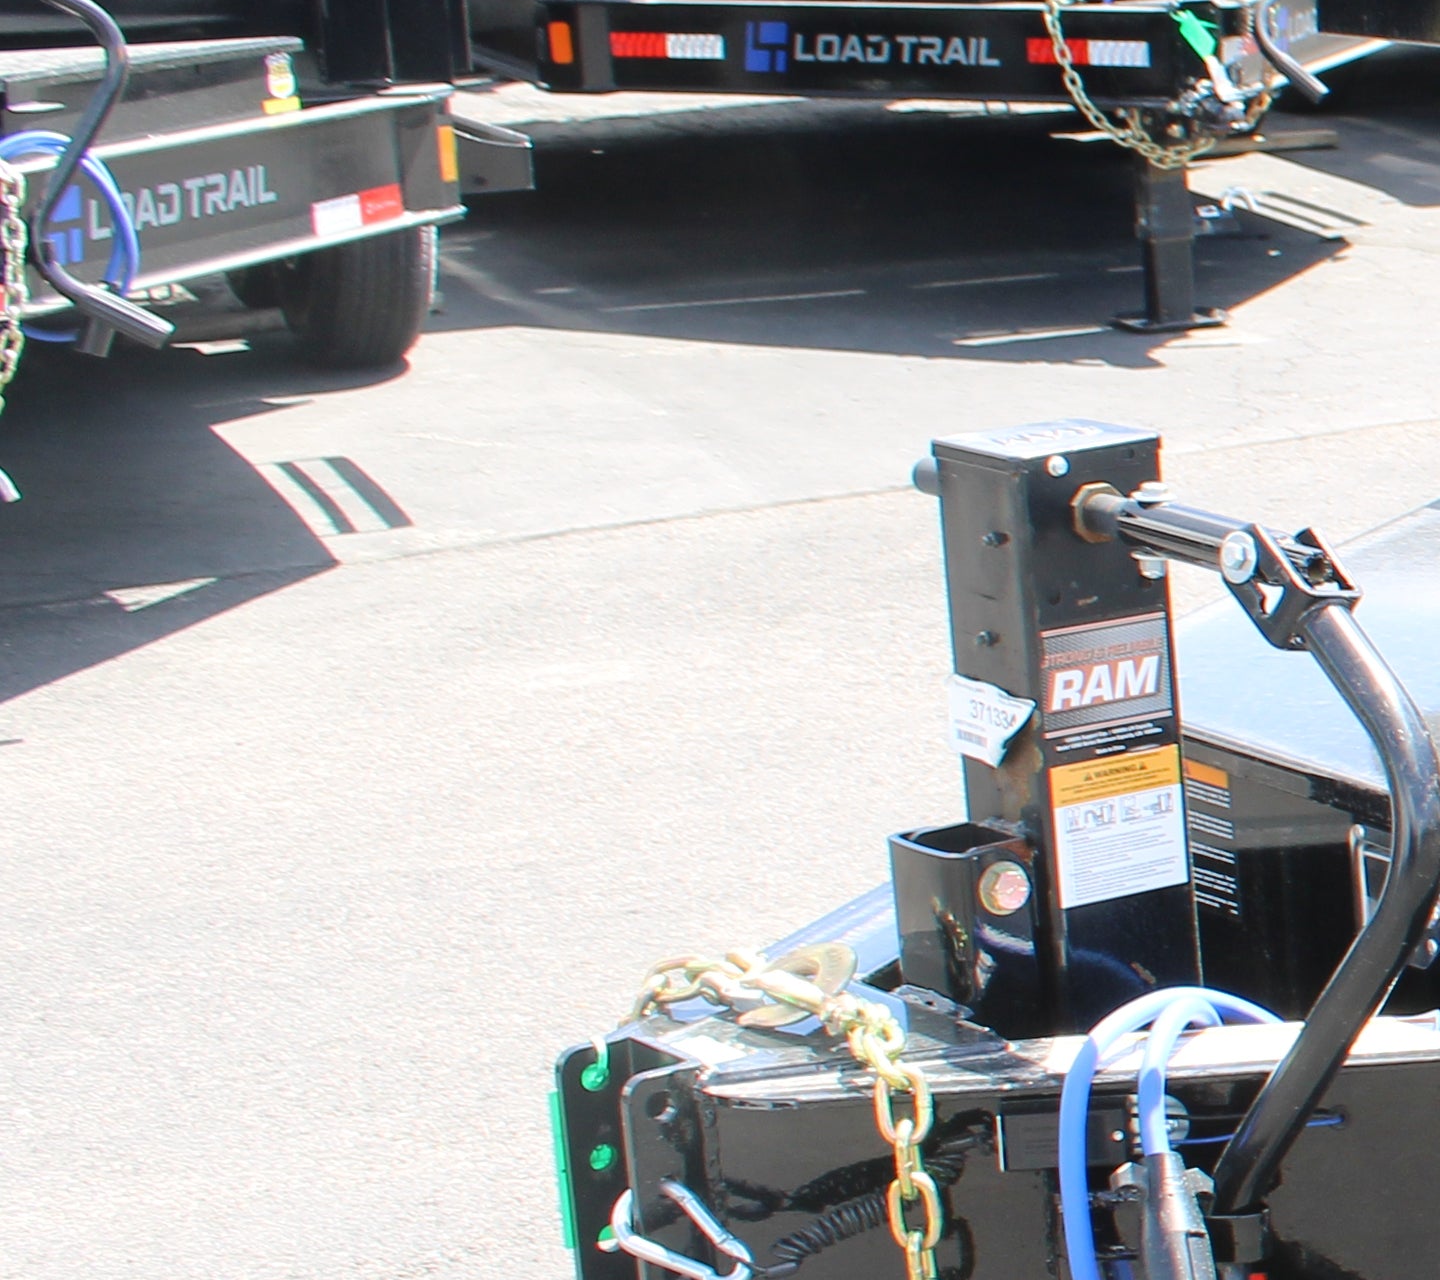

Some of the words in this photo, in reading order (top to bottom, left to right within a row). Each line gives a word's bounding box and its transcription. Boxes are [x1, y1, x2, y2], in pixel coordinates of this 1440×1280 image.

[794, 34, 890, 63] LOAD
[895, 36, 1001, 66] TRAIL
[184, 165, 278, 219] TRAIL
[1052, 655, 1160, 711] RAM
[1094, 763, 1138, 778] WARNING
